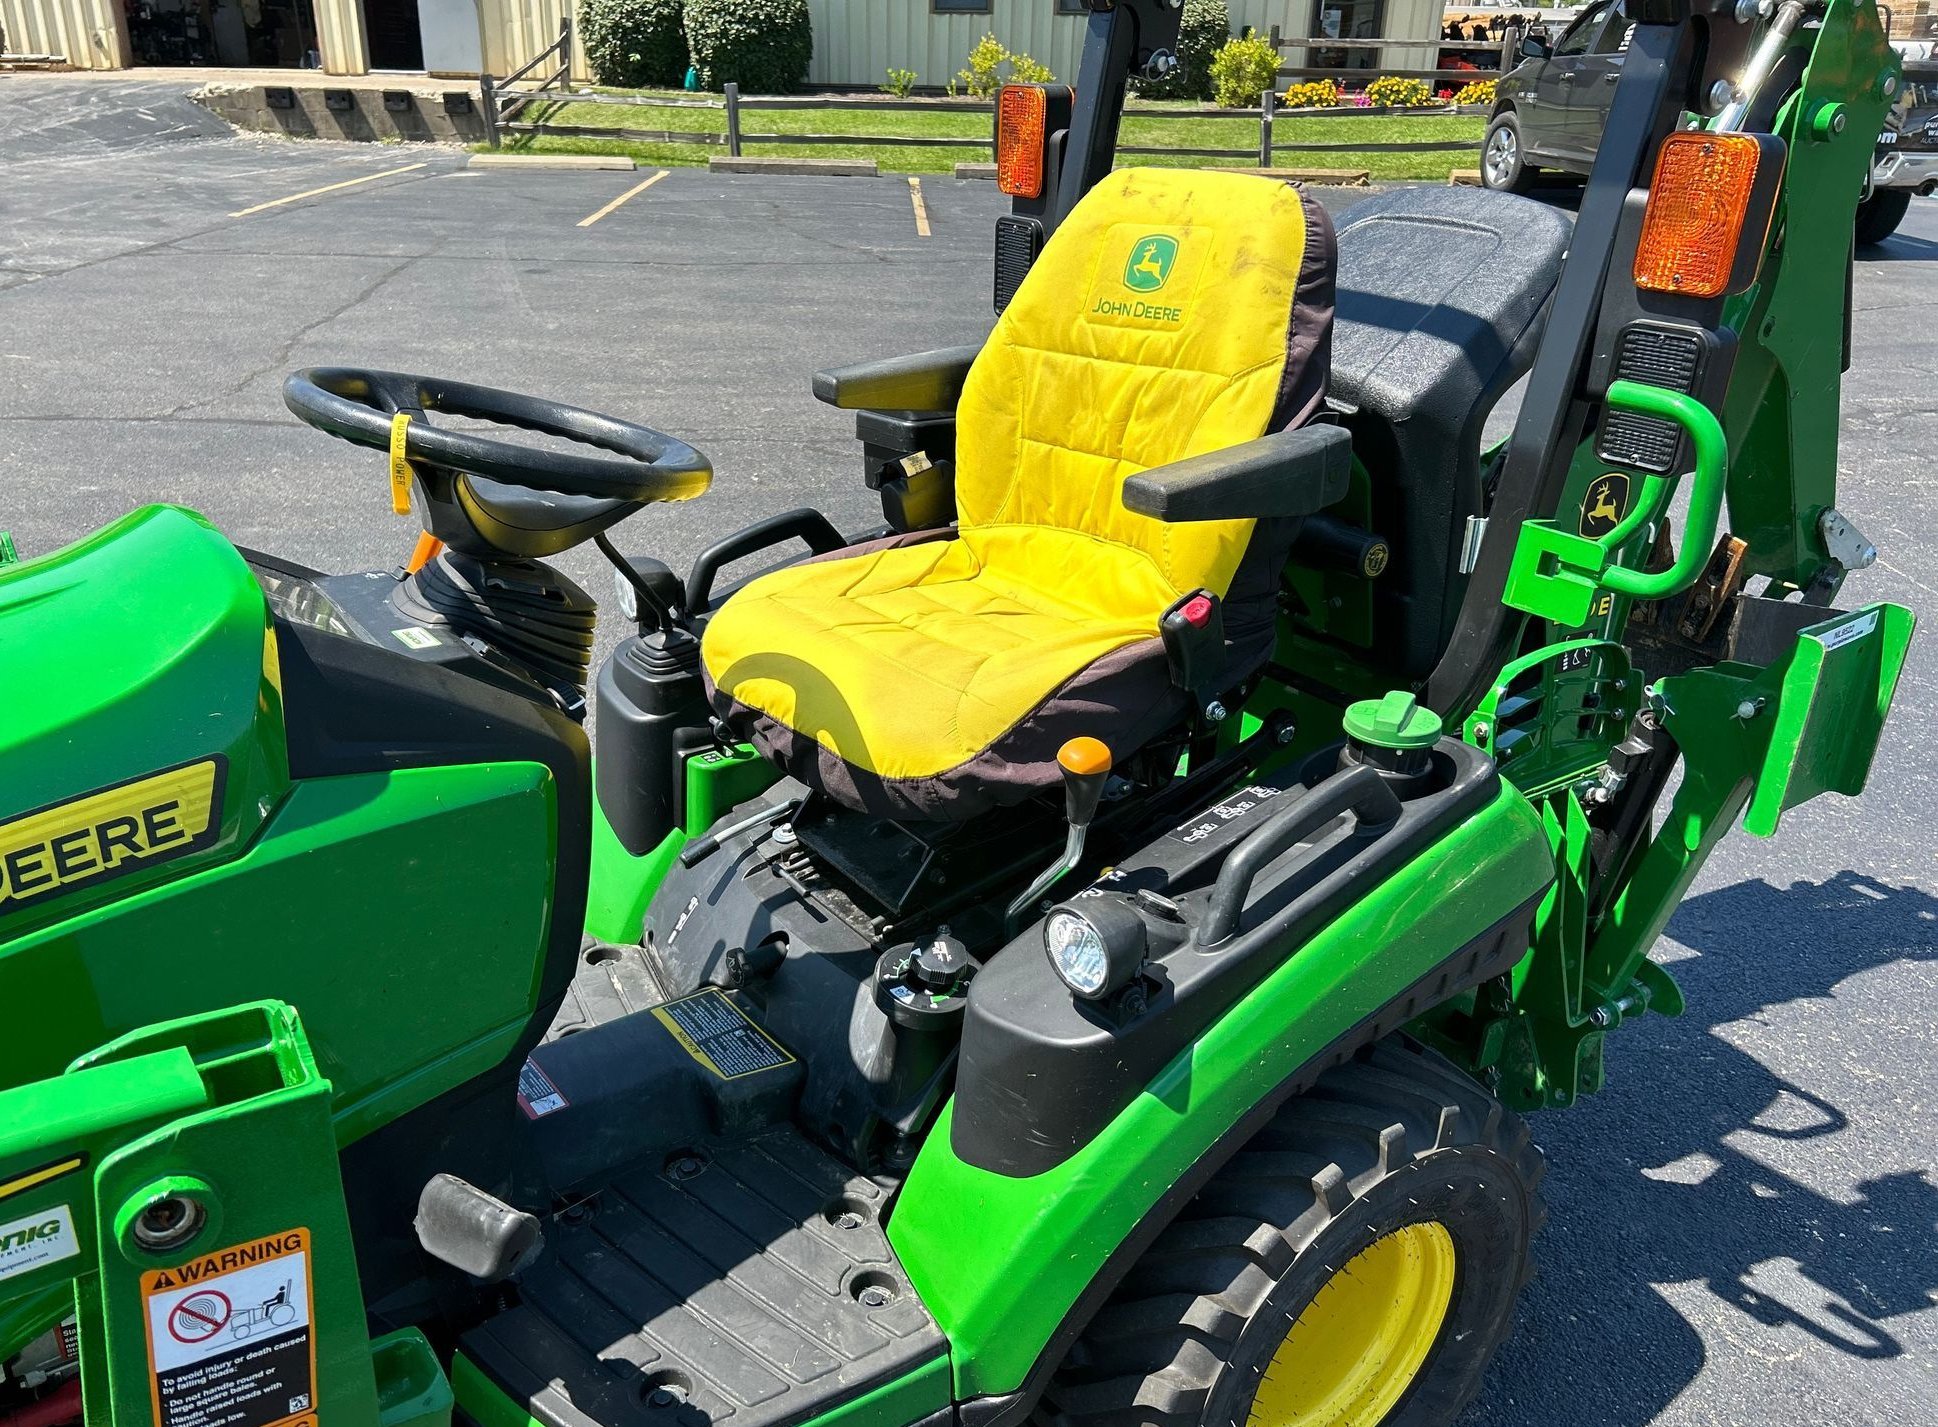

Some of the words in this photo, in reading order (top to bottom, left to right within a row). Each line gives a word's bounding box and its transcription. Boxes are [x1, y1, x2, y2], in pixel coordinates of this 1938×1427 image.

[1092, 297, 1132, 317] JOHN
[1133, 301, 1182, 322] DEERE
[395, 456, 406, 486] POWER
[0, 799, 186, 894] EERE
[176, 1233, 302, 1284] WARNING
[161, 1377, 175, 1387] To
[176, 1369, 204, 1383] avoid
[205, 1360, 232, 1375] injury
[234, 1355, 245, 1364] or
[246, 1346, 272, 1361] death
[273, 1334, 306, 1351] caused
[162, 1386, 175, 1395] by
[177, 1375, 207, 1391] falling
[208, 1366, 238, 1381] loads:
[169, 1399, 183, 1408] Do
[185, 1392, 201, 1404] not
[203, 1382, 235, 1397] handle
[236, 1370, 264, 1386] round
[265, 1366, 276, 1375] or
[170, 1402, 194, 1415] large
[196, 1391, 228, 1407] square
[230, 1381, 257, 1394] bales.
[170, 1409, 204, 1425] Handle
[206, 1398, 235, 1414] raised
[236, 1390, 262, 1403] loads
[263, 1381, 283, 1393] with
